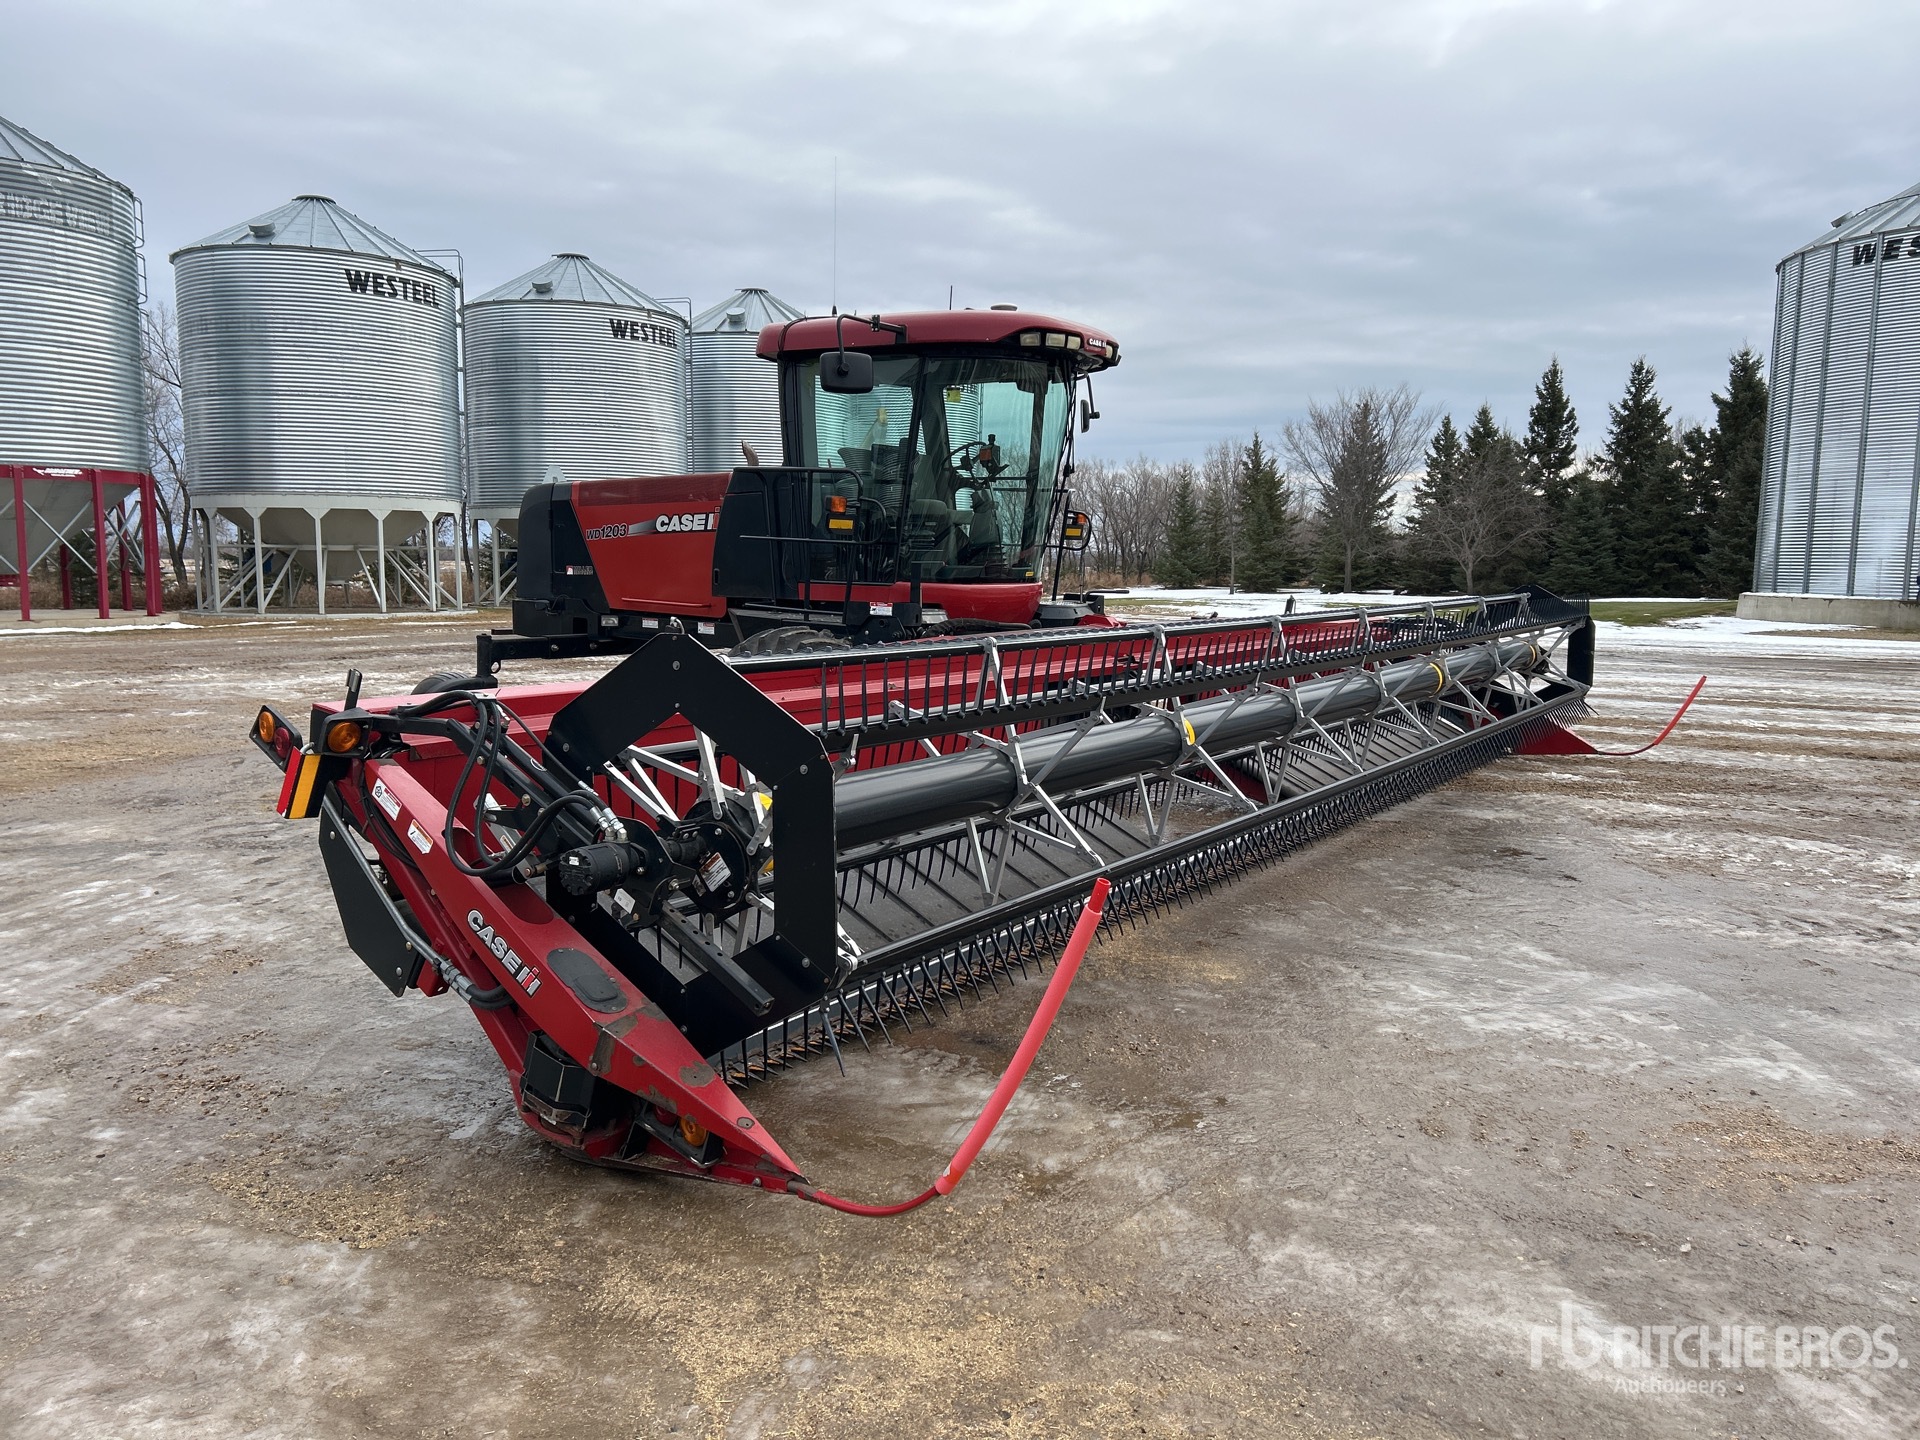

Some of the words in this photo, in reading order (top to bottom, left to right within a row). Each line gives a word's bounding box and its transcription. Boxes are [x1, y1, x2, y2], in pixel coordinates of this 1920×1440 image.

[344, 268, 440, 308] WESTEEL
[608, 318, 677, 348] WESTEEL
[1089, 338, 1102, 347] CASE
[586, 523, 627, 540] WD1203
[655, 513, 706, 532] CASE
[467, 909, 522, 975] CASE
